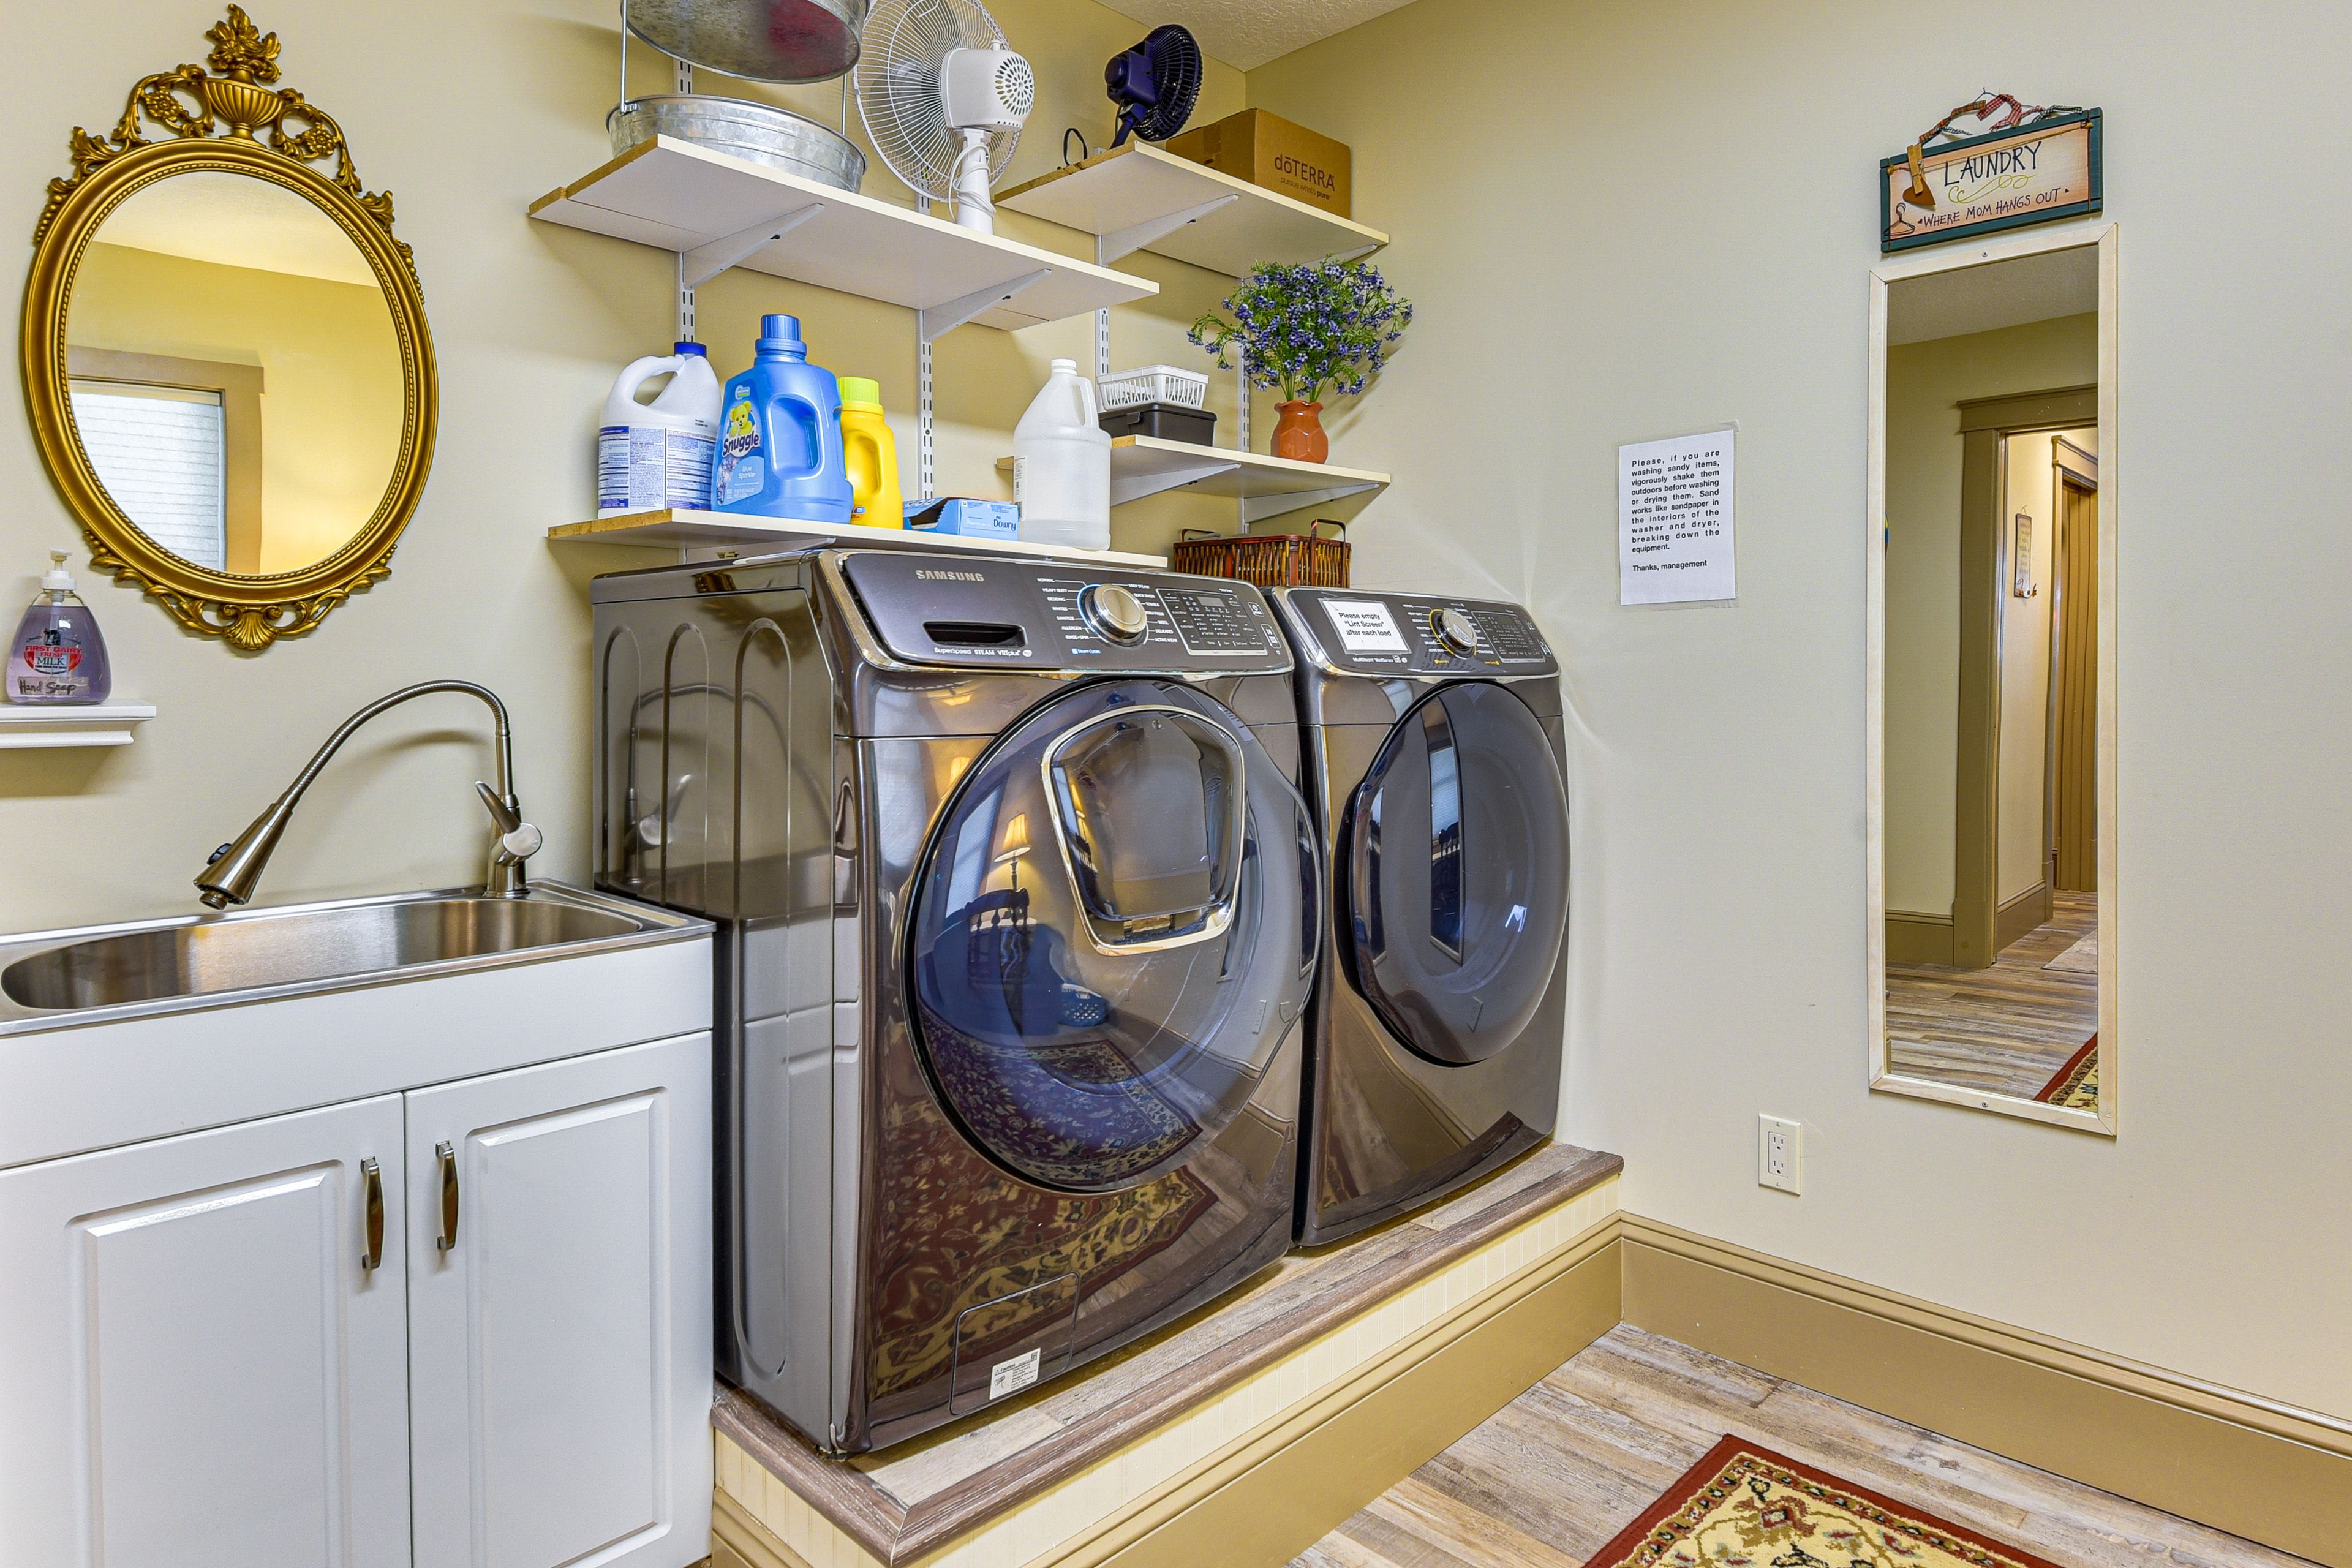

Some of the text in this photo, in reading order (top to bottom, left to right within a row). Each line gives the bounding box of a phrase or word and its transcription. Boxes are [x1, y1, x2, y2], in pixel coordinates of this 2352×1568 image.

[1944, 141, 2041, 186] LAUNDRY
[1275, 154, 1335, 191] dōTERRA
[1924, 188, 2060, 227] WHERE MOM HANGS OUT
[723, 431, 759, 456] Snuggle
[1632, 458, 1665, 467] Please,
[1683, 453, 1698, 462] you
[1632, 467, 1662, 477] washing
[1667, 463, 1690, 472] sandy
[1631, 476, 1668, 486] vigorously
[1631, 480, 1719, 496] outdoors before washing
[1699, 489, 1719, 497] Sand
[1671, 500, 1709, 510] sandpaper
[1649, 513, 1686, 522] interiors
[993, 519, 1016, 531] Downy
[1632, 525, 1664, 533] washer
[1632, 534, 1670, 543] breaking
[1632, 543, 1670, 554] equipment.
[1632, 560, 1708, 572] Thanks, management
[916, 570, 984, 582] SAMSUNG
[37, 657, 66, 666] MILK
[19, 679, 77, 695] Hand Soap
